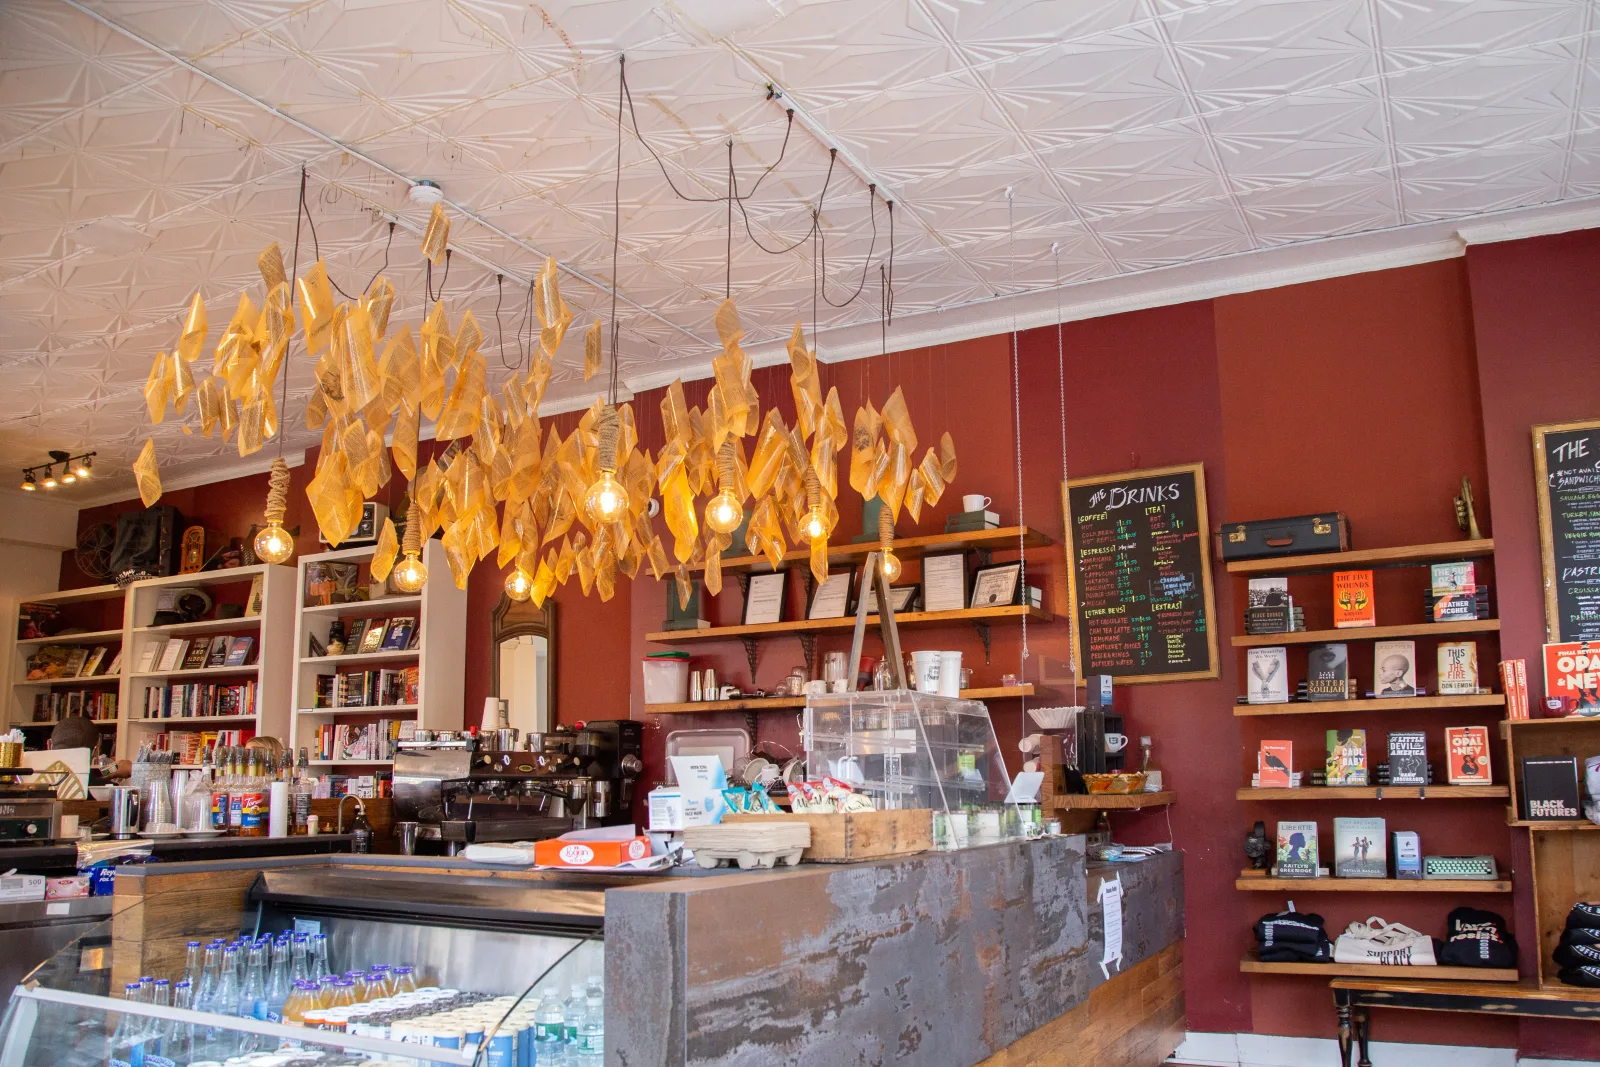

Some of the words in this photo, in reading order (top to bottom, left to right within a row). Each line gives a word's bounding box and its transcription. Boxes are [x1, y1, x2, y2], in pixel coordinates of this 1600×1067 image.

[1553, 438, 1589, 462] THE
[1558, 474, 1600, 489] SANDWICH
[1089, 489, 1107, 508] THE
[1105, 484, 1180, 511] DRINKS
[1434, 568, 1450, 577] THE
[1562, 567, 1600, 580] PASTR
[1568, 587, 1600, 595] CROISSA
[1439, 600, 1469, 608] HEATHER
[1447, 648, 1466, 657] THIS
[1453, 656, 1461, 664] IS
[1449, 663, 1463, 671] THE
[1447, 670, 1466, 679] FIRE
[1566, 672, 1600, 690] NE
[1390, 742, 1420, 750] DEVIL
[1452, 737, 1483, 746] OPAL
[1342, 748, 1364, 756] CAUL
[1457, 746, 1482, 755] NEV
[1343, 757, 1364, 765] BABY
[1530, 800, 1565, 808] BLACK
[1531, 808, 1577, 817] FUTURES
[1366, 945, 1412, 958] SUPPORT
